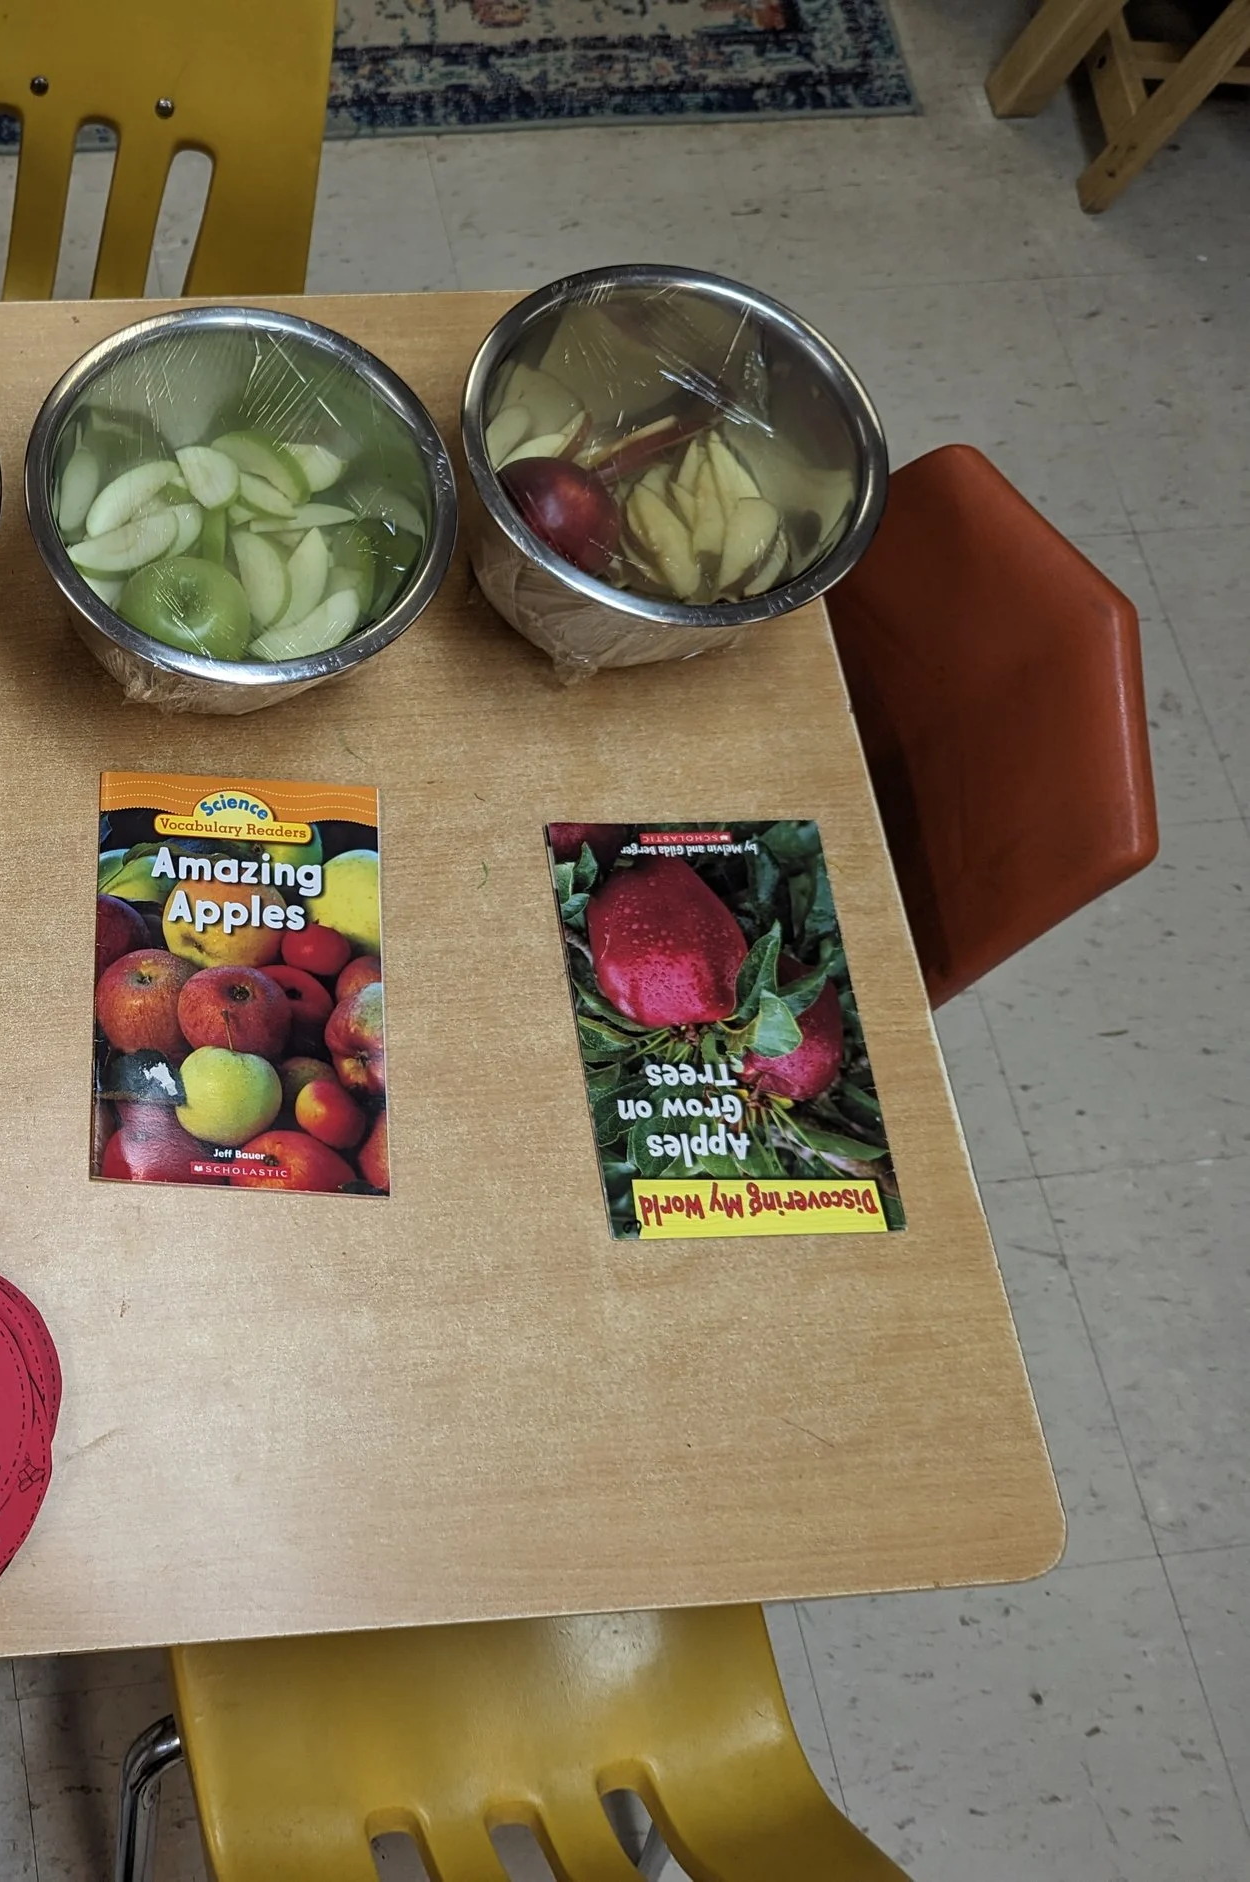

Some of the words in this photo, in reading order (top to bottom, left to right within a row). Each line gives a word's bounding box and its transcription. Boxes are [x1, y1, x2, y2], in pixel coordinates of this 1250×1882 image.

[200, 798, 269, 821] Science
[160, 818, 242, 837] Vocabulary
[246, 823, 307, 838] Readers
[640, 833, 718, 843] SCHOLASTIC
[620, 842, 656, 856] Berger
[657, 844, 684, 857] Gilda
[685, 845, 705, 857] and
[706, 843, 742, 856] Melvin
[744, 839, 759, 855] by
[151, 846, 321, 896] Amazing
[167, 889, 305, 933] Apples
[644, 1062, 737, 1087] Trees
[616, 1099, 653, 1120] on
[661, 1093, 742, 1124] Grow
[213, 1148, 233, 1159] Jeff
[234, 1149, 266, 1160] Bauer
[646, 1124, 751, 1168] Apples
[205, 1165, 288, 1178] SCHOLASTIC
[710, 1182, 743, 1219] My
[749, 1182, 879, 1216] Discovering
[639, 1194, 705, 1226] World
